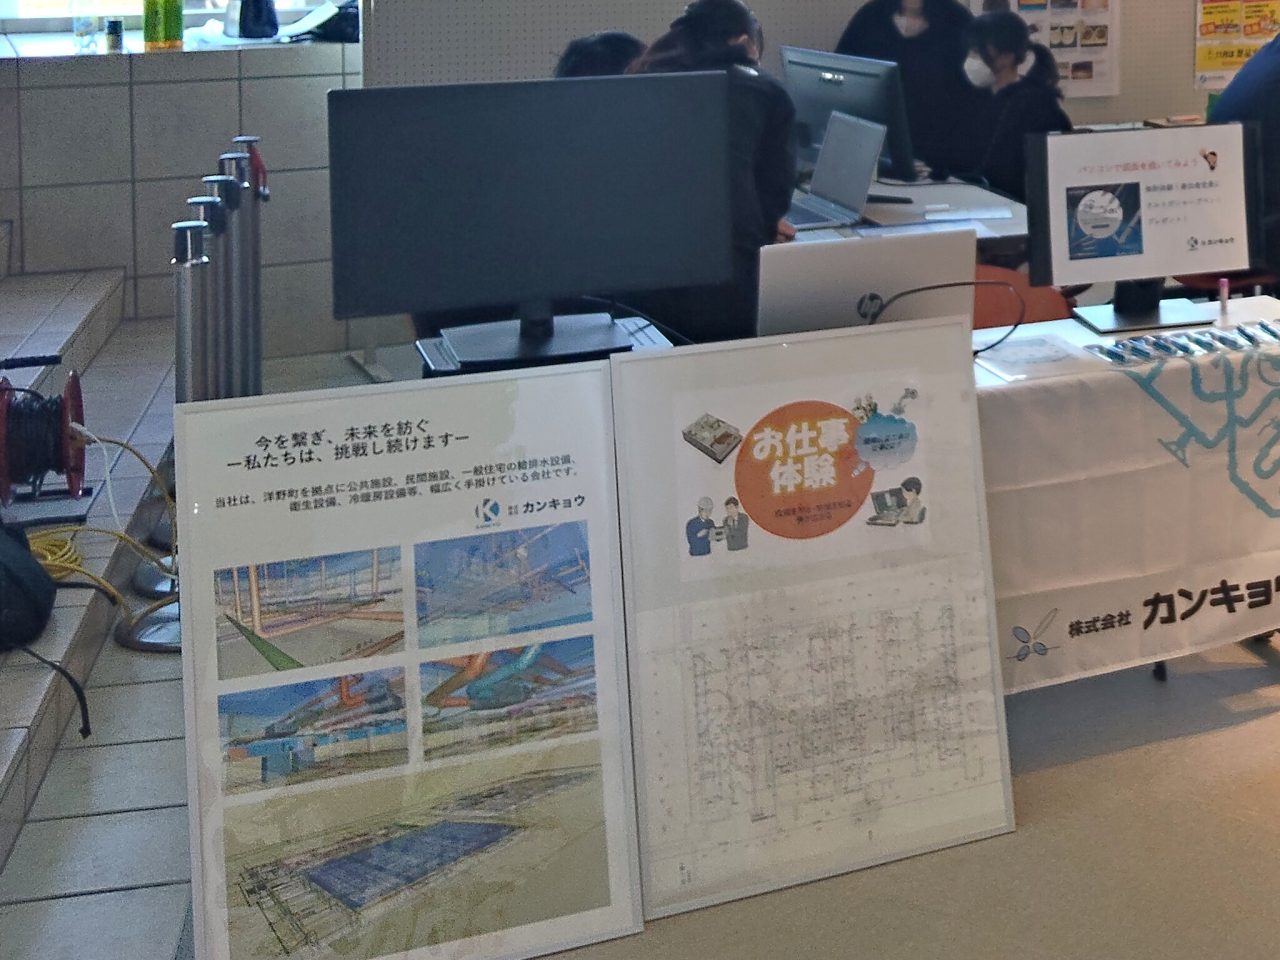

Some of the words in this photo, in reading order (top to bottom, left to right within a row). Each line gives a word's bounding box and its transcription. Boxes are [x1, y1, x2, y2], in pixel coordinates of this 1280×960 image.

[752, 417, 850, 461] お仕事
[769, 452, 837, 496] 体験
[522, 493, 586, 515] カンキョウ
[1068, 609, 1132, 639] 株式会社
